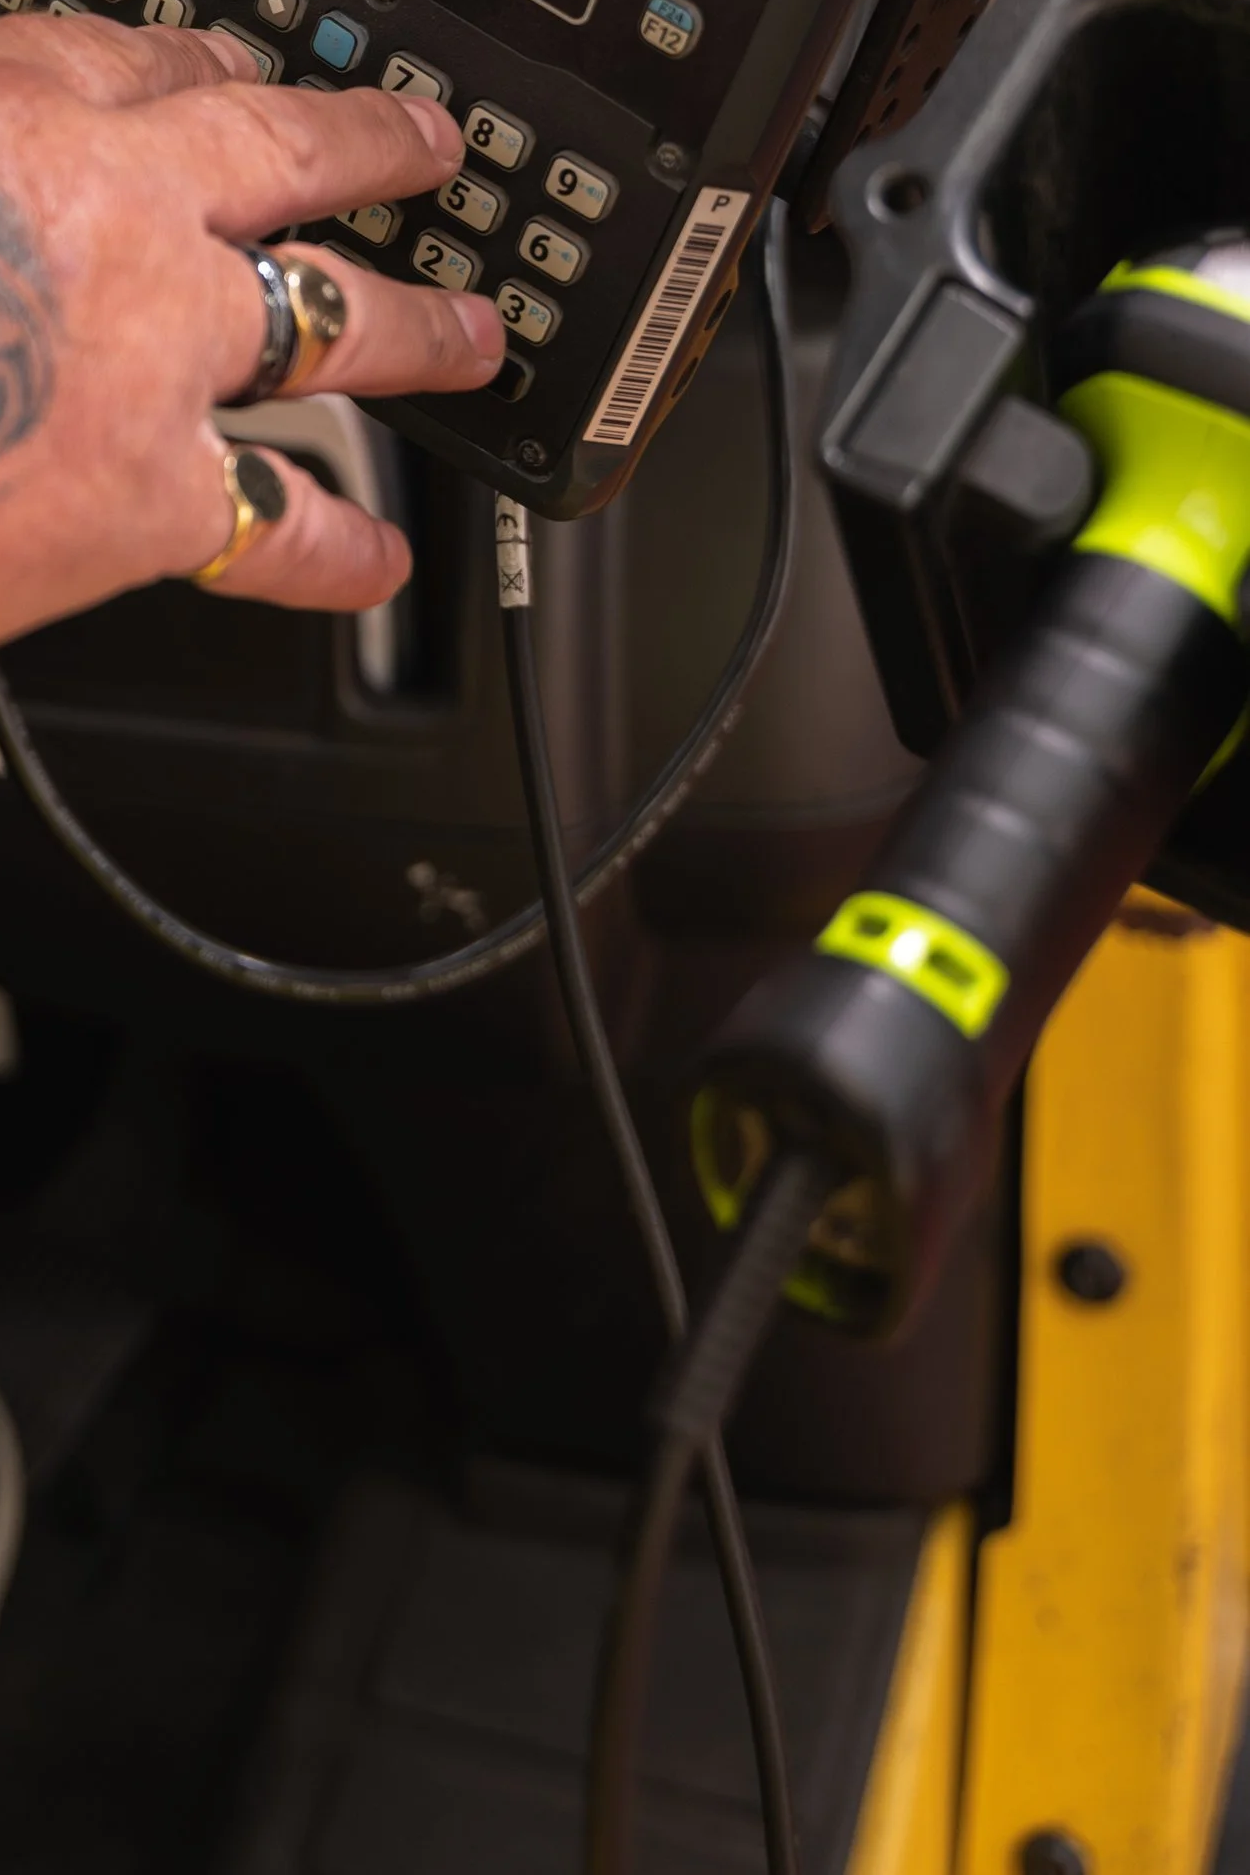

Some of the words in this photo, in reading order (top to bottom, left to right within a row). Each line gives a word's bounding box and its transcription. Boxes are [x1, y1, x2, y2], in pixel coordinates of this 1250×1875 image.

[153, 0, 171, 24] L
[643, 19, 681, 52] F12
[391, 64, 414, 91] 7
[471, 117, 495, 148] 8
[557, 168, 579, 197] 9
[710, 194, 731, 212] P
[446, 180, 471, 212] 5
[529, 234, 552, 263] 6
[420, 243, 444, 277] 2
[447, 255, 467, 276] P2
[501, 294, 526, 325] 3
[528, 305, 548, 325] P3
